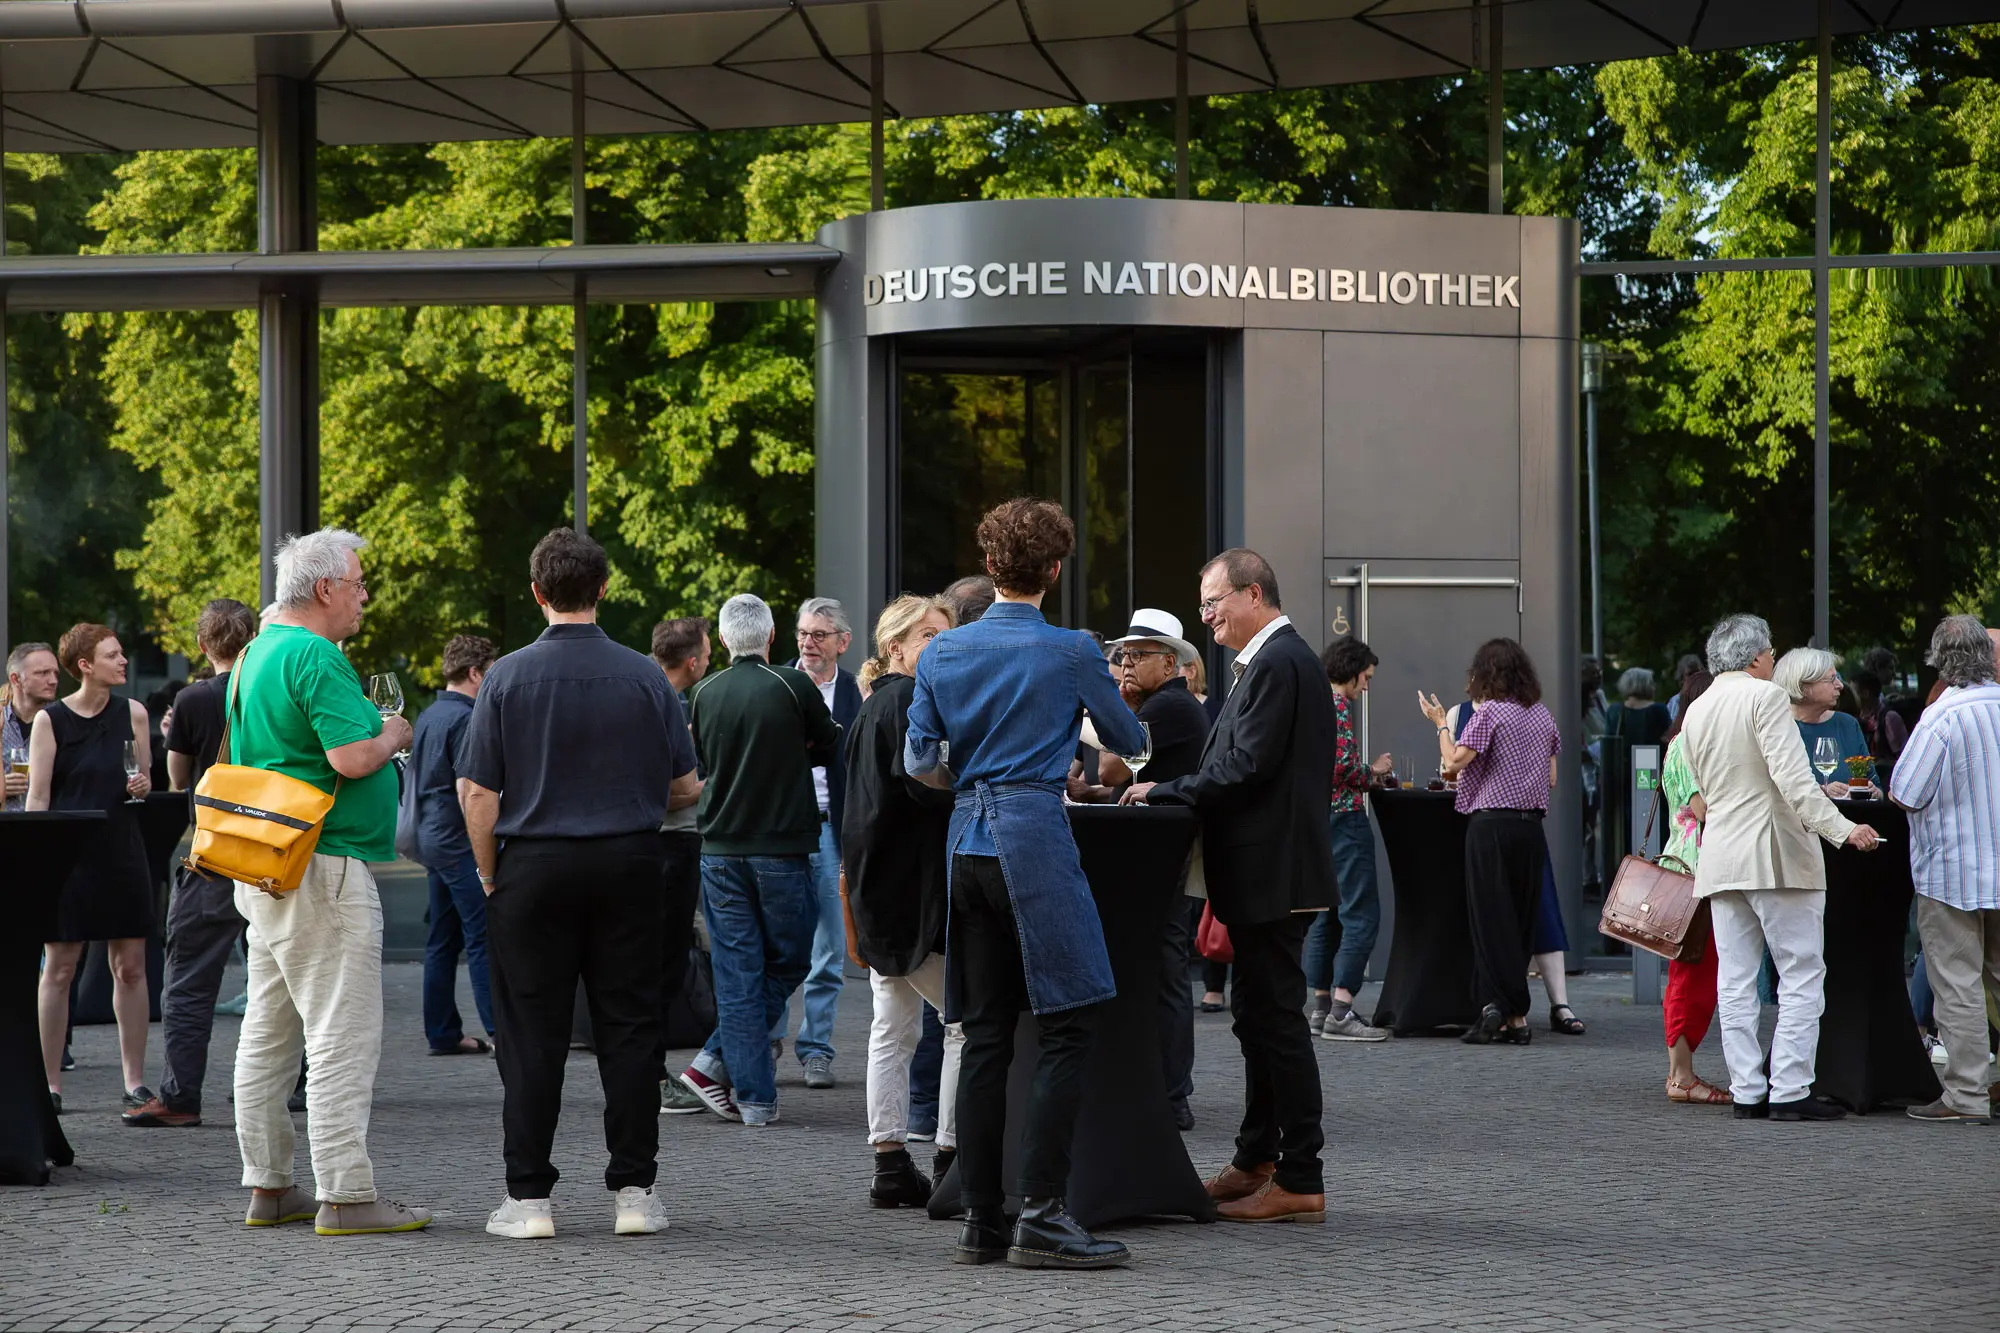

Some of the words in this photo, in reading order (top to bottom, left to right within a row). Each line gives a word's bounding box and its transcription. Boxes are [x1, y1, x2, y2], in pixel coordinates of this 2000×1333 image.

[863, 261, 1067, 306] DEUTSCHE
[1083, 261, 1521, 308] NATIONALBIBLIOTHEK
[245, 808, 267, 817] VAUDE
